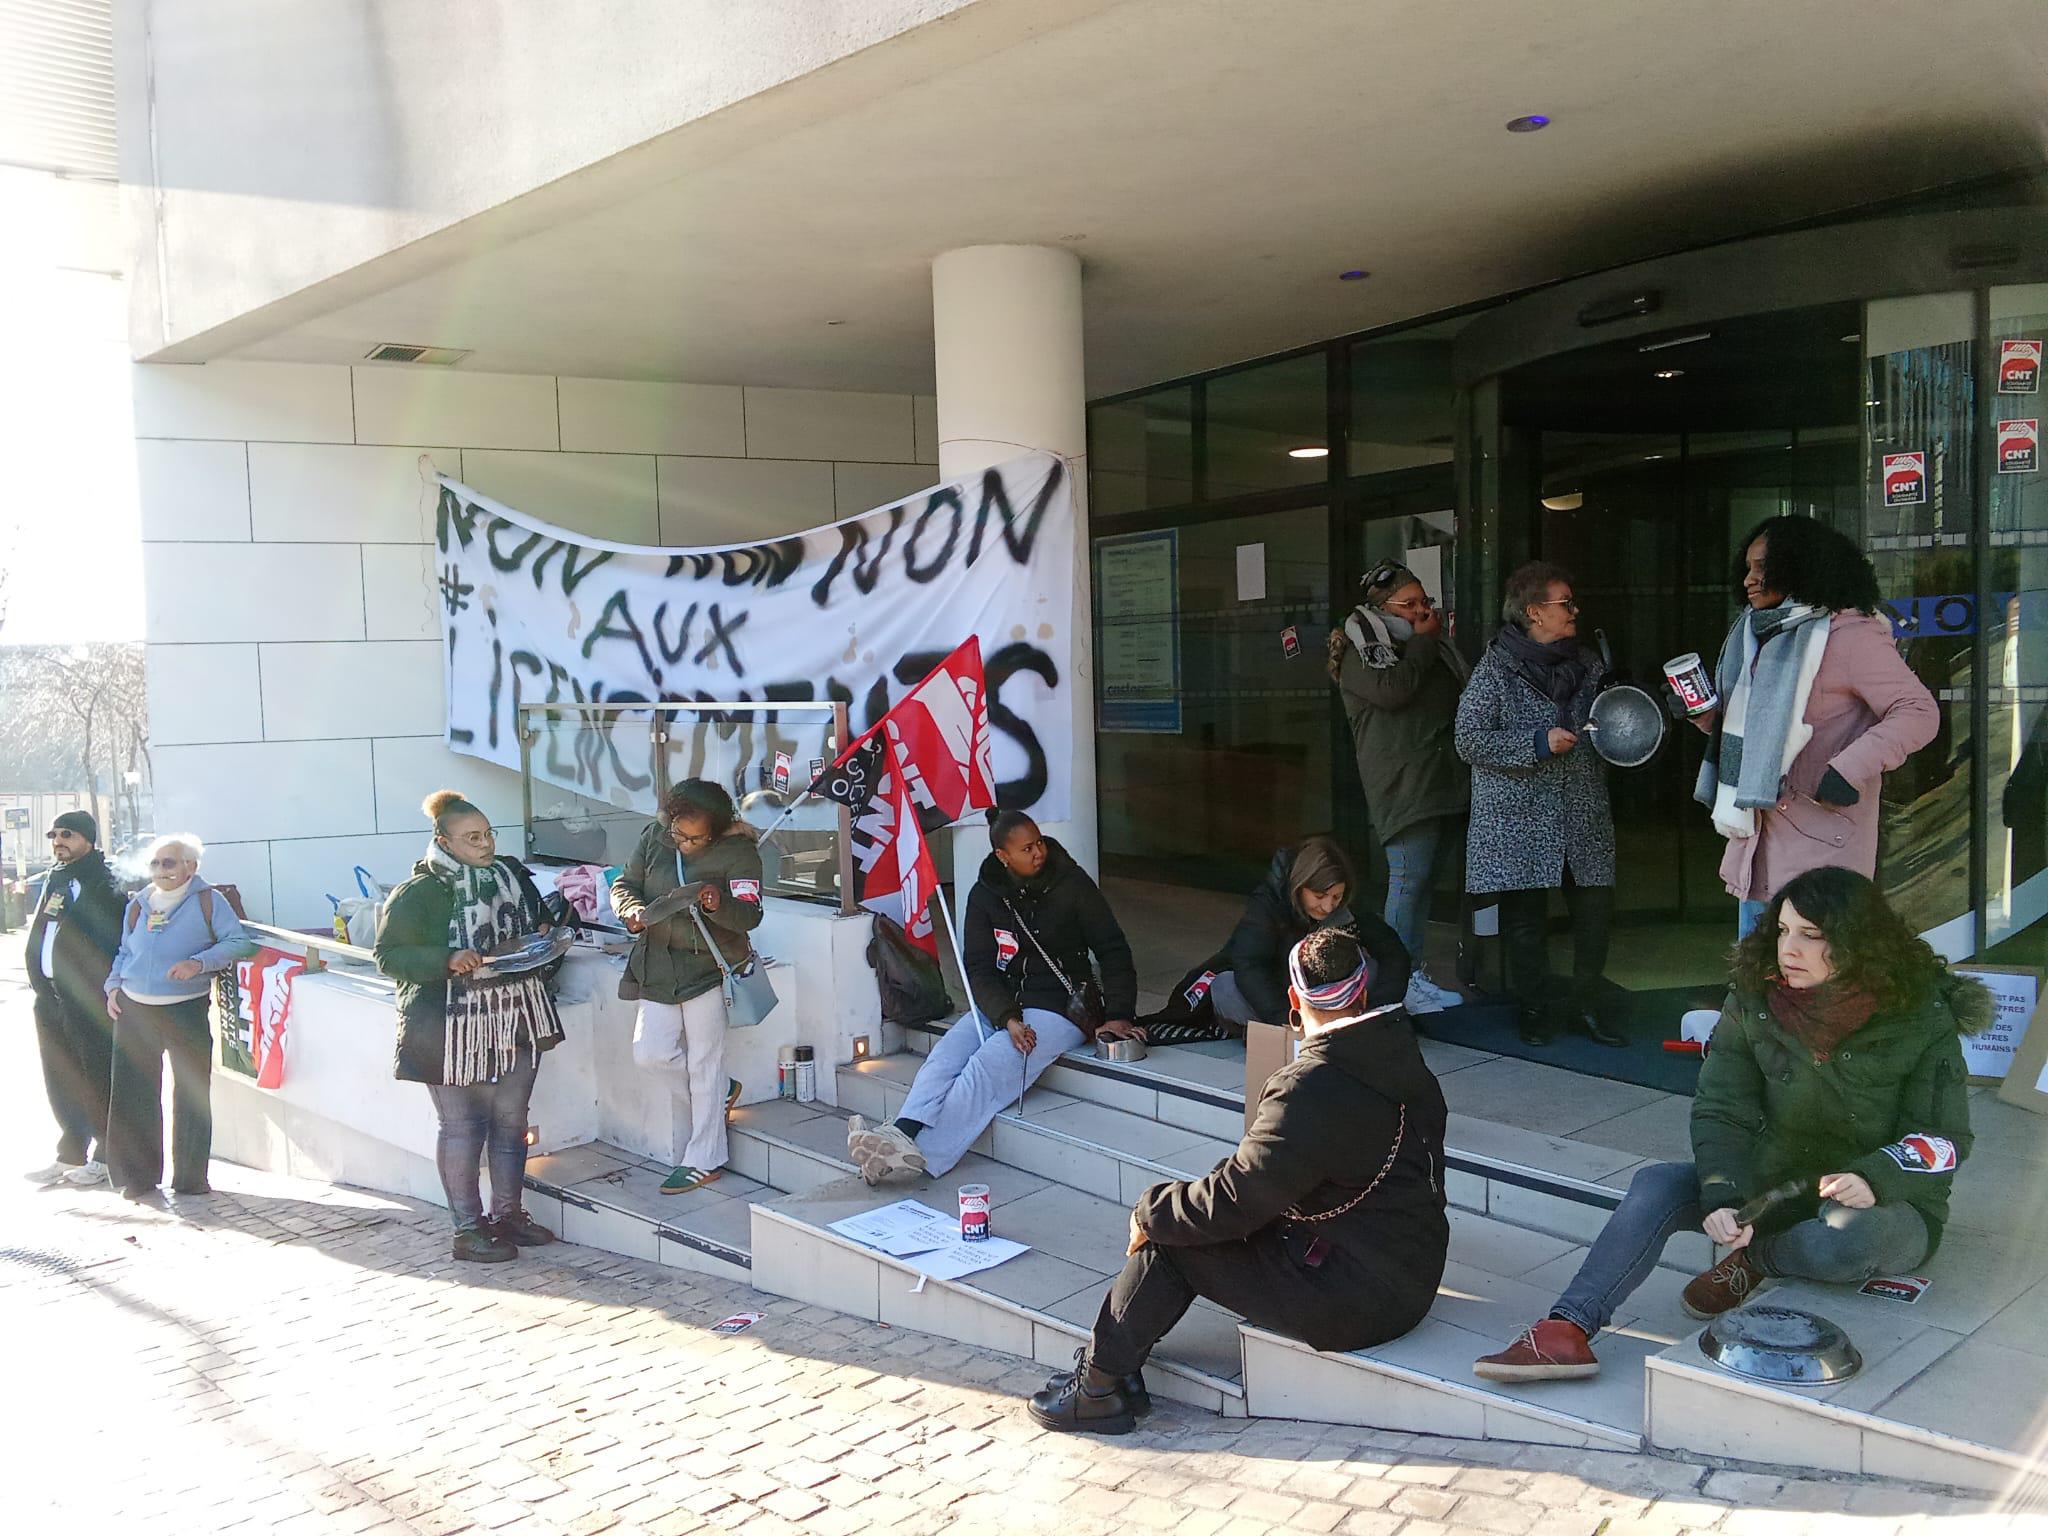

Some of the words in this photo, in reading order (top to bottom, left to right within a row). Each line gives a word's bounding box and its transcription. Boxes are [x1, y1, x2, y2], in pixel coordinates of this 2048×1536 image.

[2006, 370, 2033, 380] CNT
[2005, 449, 2032, 460] CNT
[1891, 481, 1918, 493] CNT
[811, 458, 1064, 609] NON
[582, 590, 749, 687] AUX
[1679, 679, 1698, 702] CNT
[237, 961, 255, 1053] CNT
[1995, 1024, 2013, 1032] DES
[1971, 1043, 2011, 1053] HUMAINS
[964, 1223, 986, 1234] CNT
[1872, 1285, 1912, 1296] CNT
